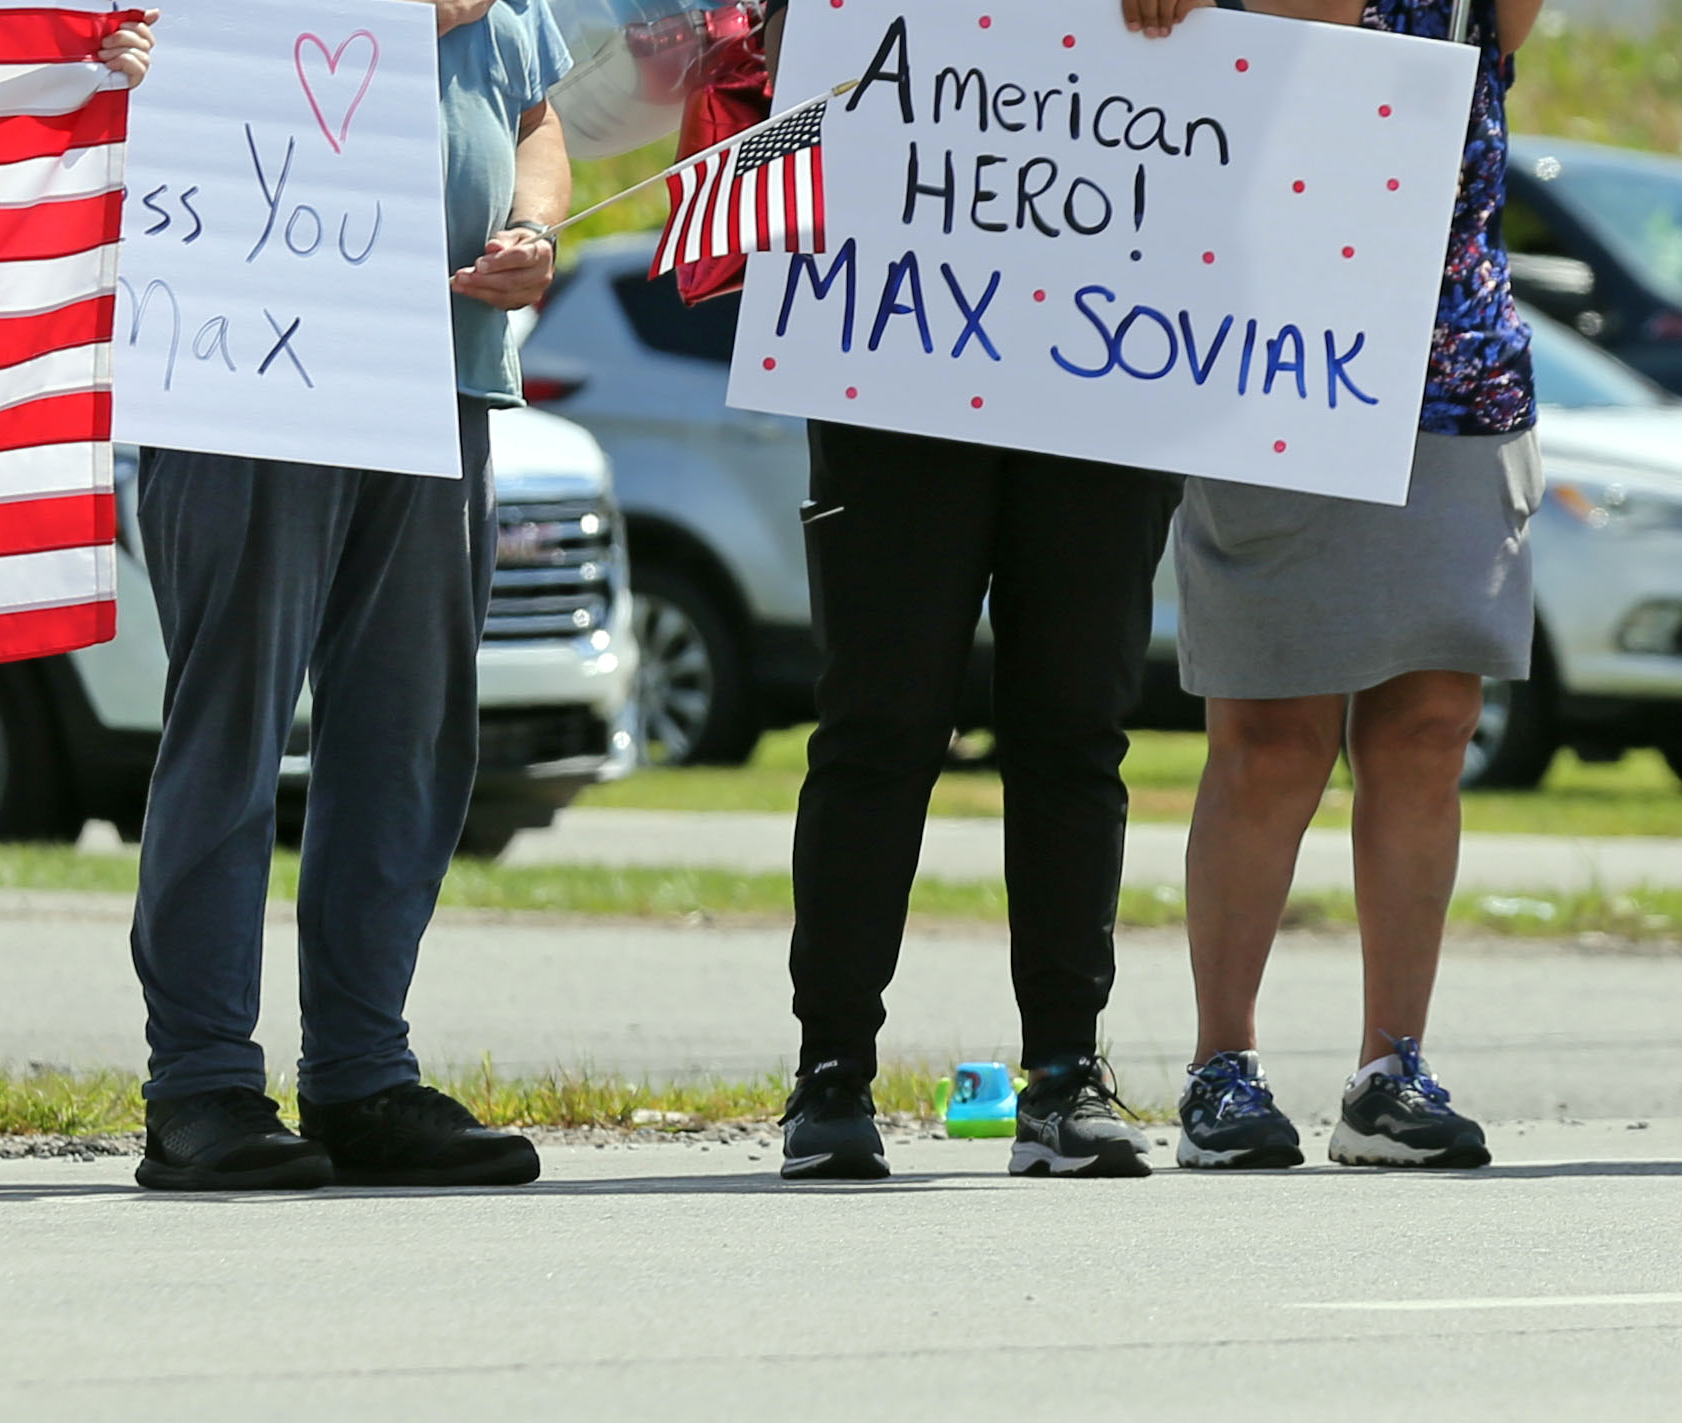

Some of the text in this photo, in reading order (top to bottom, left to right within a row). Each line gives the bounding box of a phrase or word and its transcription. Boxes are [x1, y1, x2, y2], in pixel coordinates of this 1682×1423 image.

[845, 16, 1229, 166] American
[903, 142, 1148, 262] HERO!
[775, 237, 1379, 409] MAX SOVIAK
